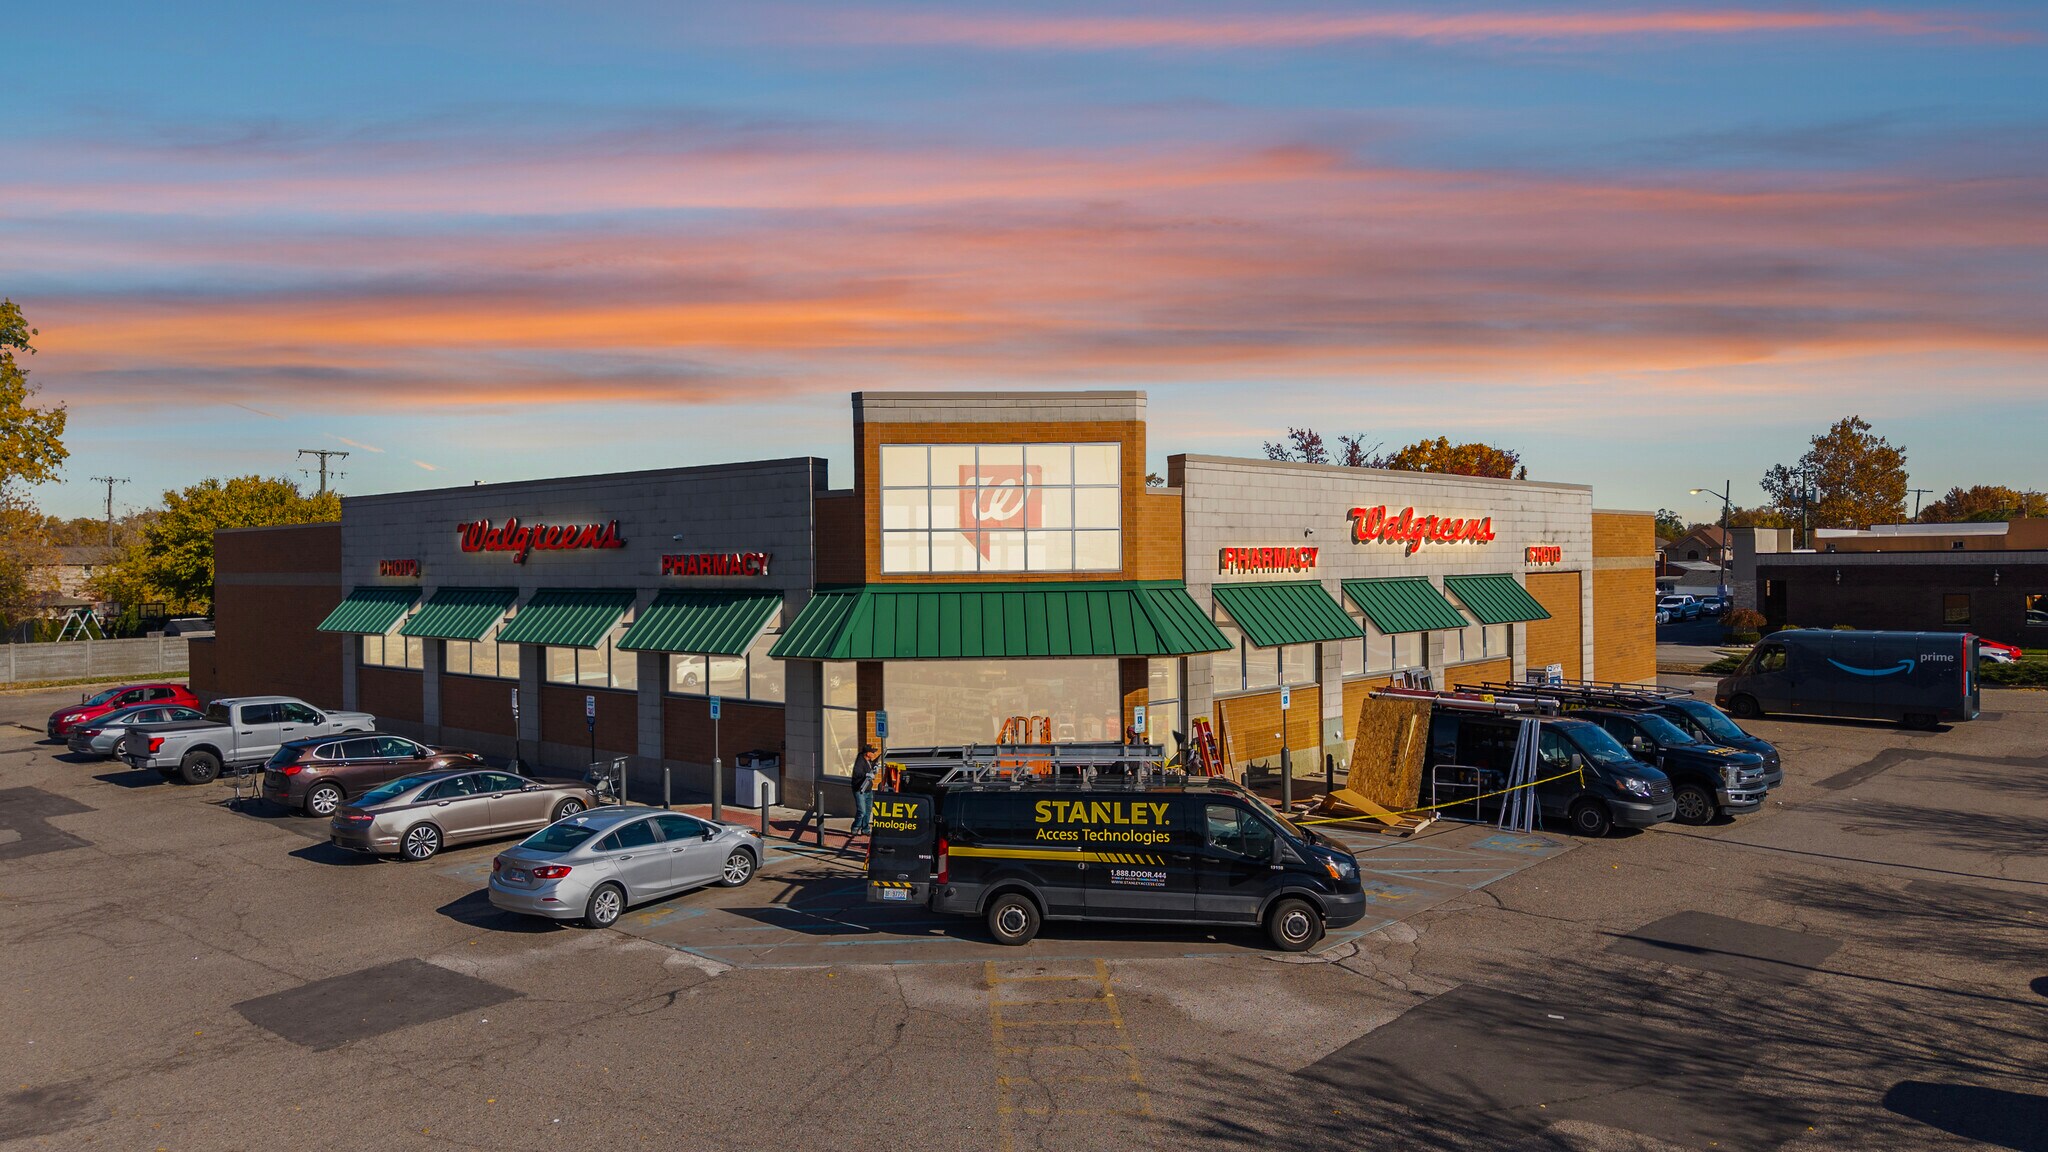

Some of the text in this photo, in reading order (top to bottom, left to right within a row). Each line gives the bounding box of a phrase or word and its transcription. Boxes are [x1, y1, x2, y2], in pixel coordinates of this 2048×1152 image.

[1350, 505, 1496, 554] Walgreens
[457, 517, 625, 564] Walgreens
[661, 553, 770, 577] PHARMACY
[1222, 547, 1319, 571] PHARMACY
[1528, 546, 1561, 563] PHOTO
[379, 559, 418, 577] PHOTO
[1920, 651, 1954, 663] prime
[1036, 828, 1170, 845] Access Technologies
